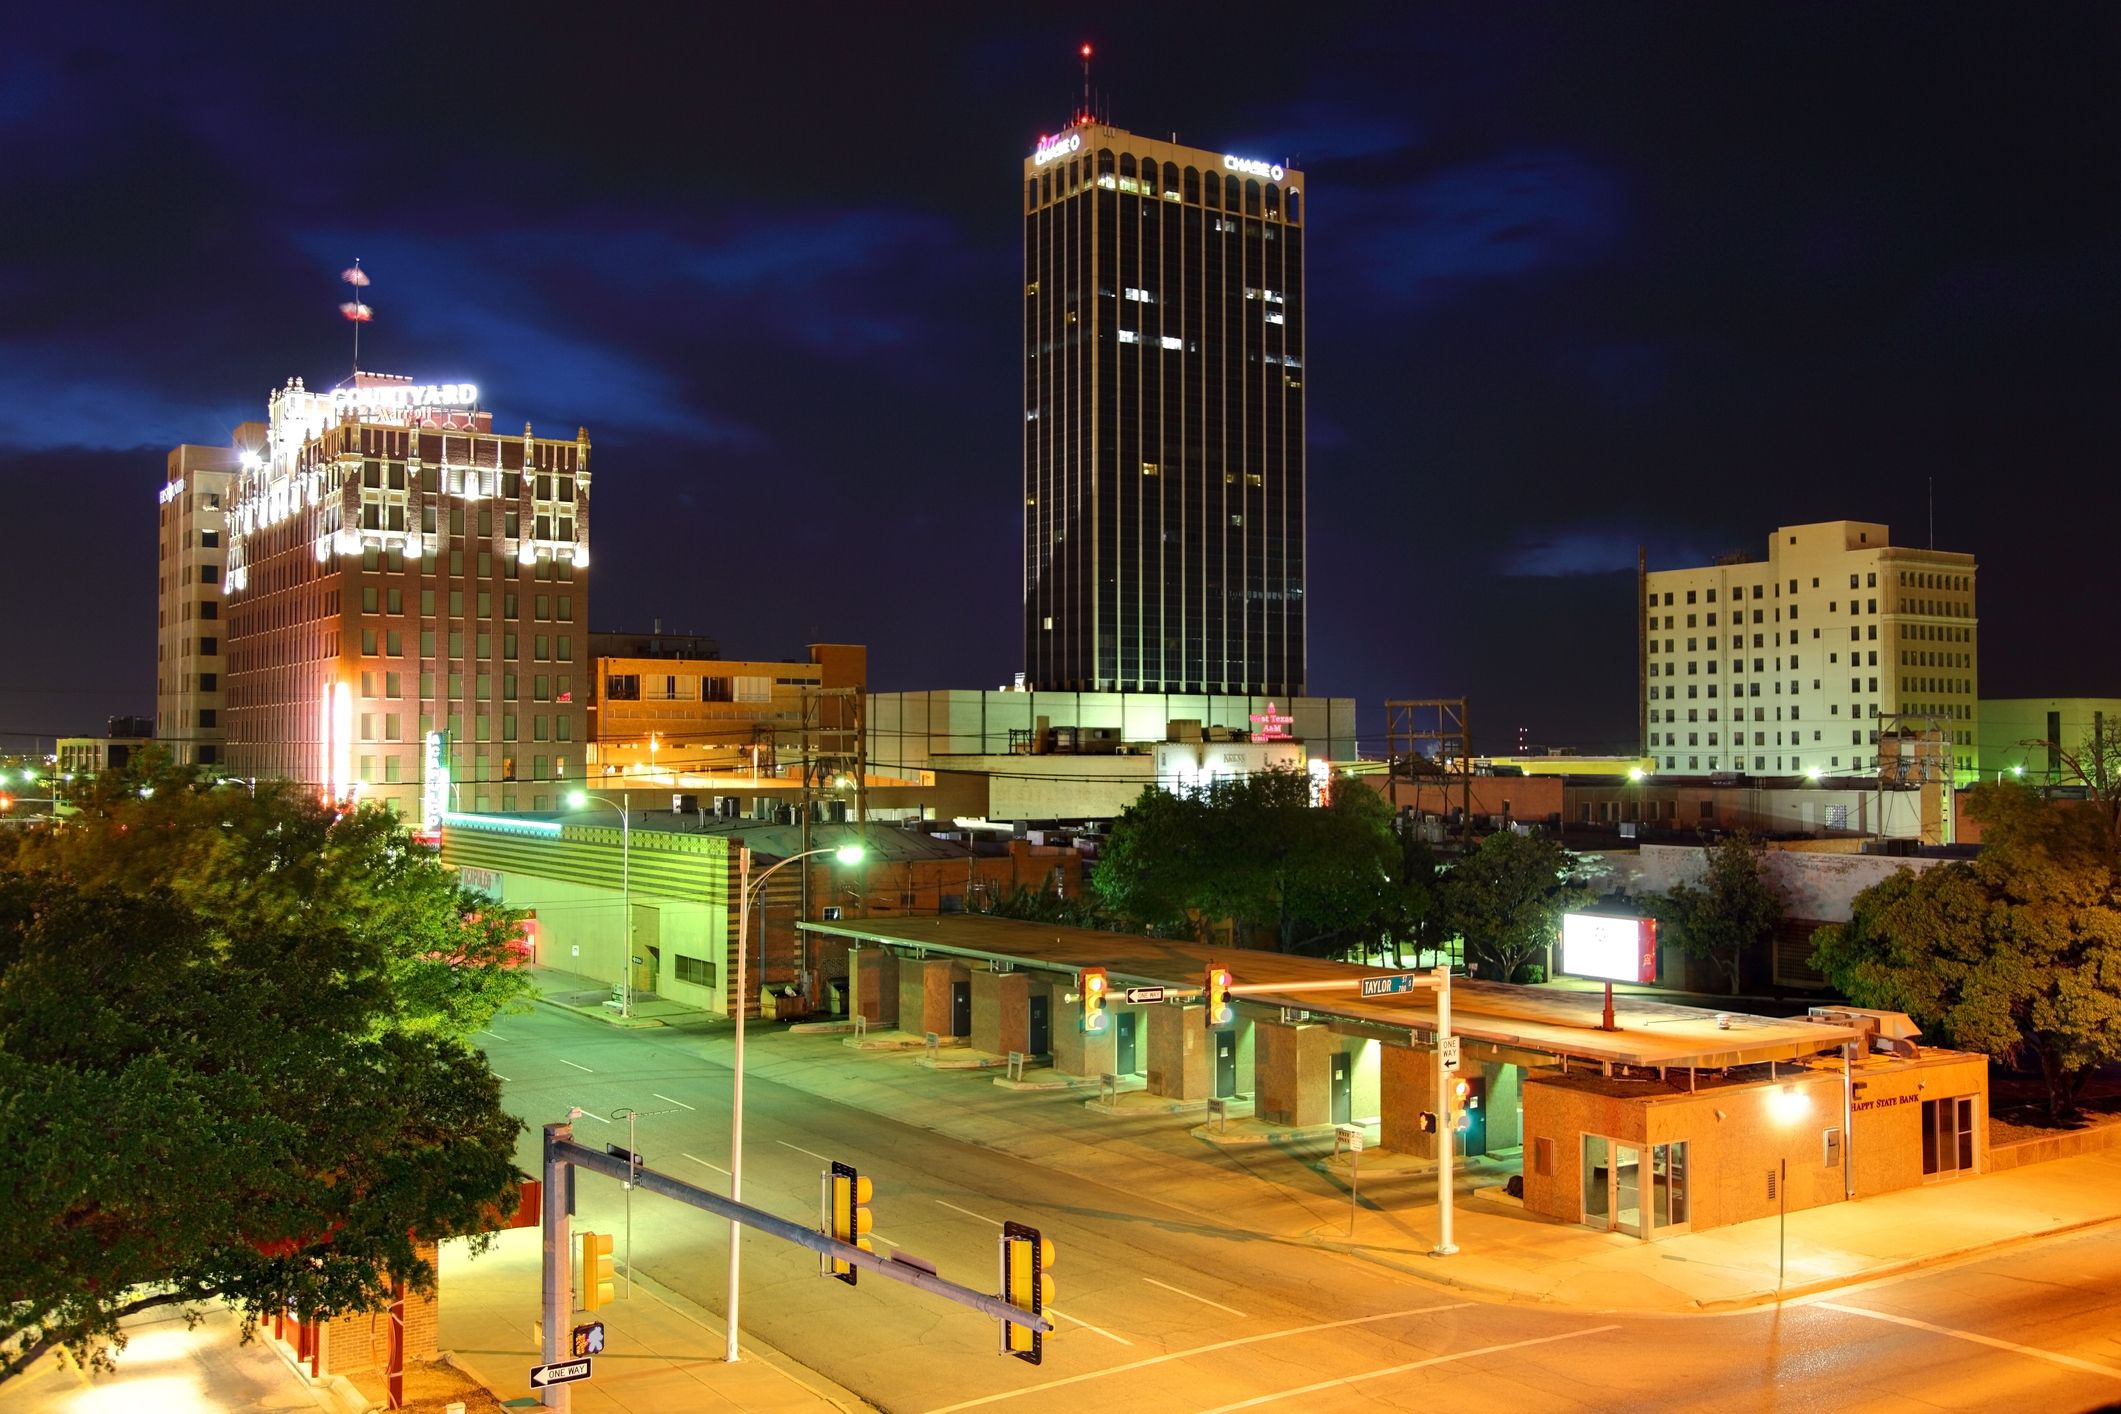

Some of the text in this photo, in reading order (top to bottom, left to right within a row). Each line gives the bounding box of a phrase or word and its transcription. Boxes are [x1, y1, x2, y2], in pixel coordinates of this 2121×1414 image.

[1035, 138, 1070, 166] CHASE
[1224, 154, 1271, 178] CHASE
[330, 384, 478, 405] COURTYARD
[377, 405, 432, 422] Marriott
[1250, 713, 1294, 724] West Texas
[1263, 724, 1282, 733] A&M
[1223, 753, 1246, 763] KRESS
[1365, 979, 1392, 994] TAYLOR
[1443, 1040, 1456, 1048] ONE
[1443, 1049, 1457, 1057] WAY
[1851, 1094, 1919, 1112] HAPPY STATE BANK
[549, 1365, 585, 1379] ONE WAY
